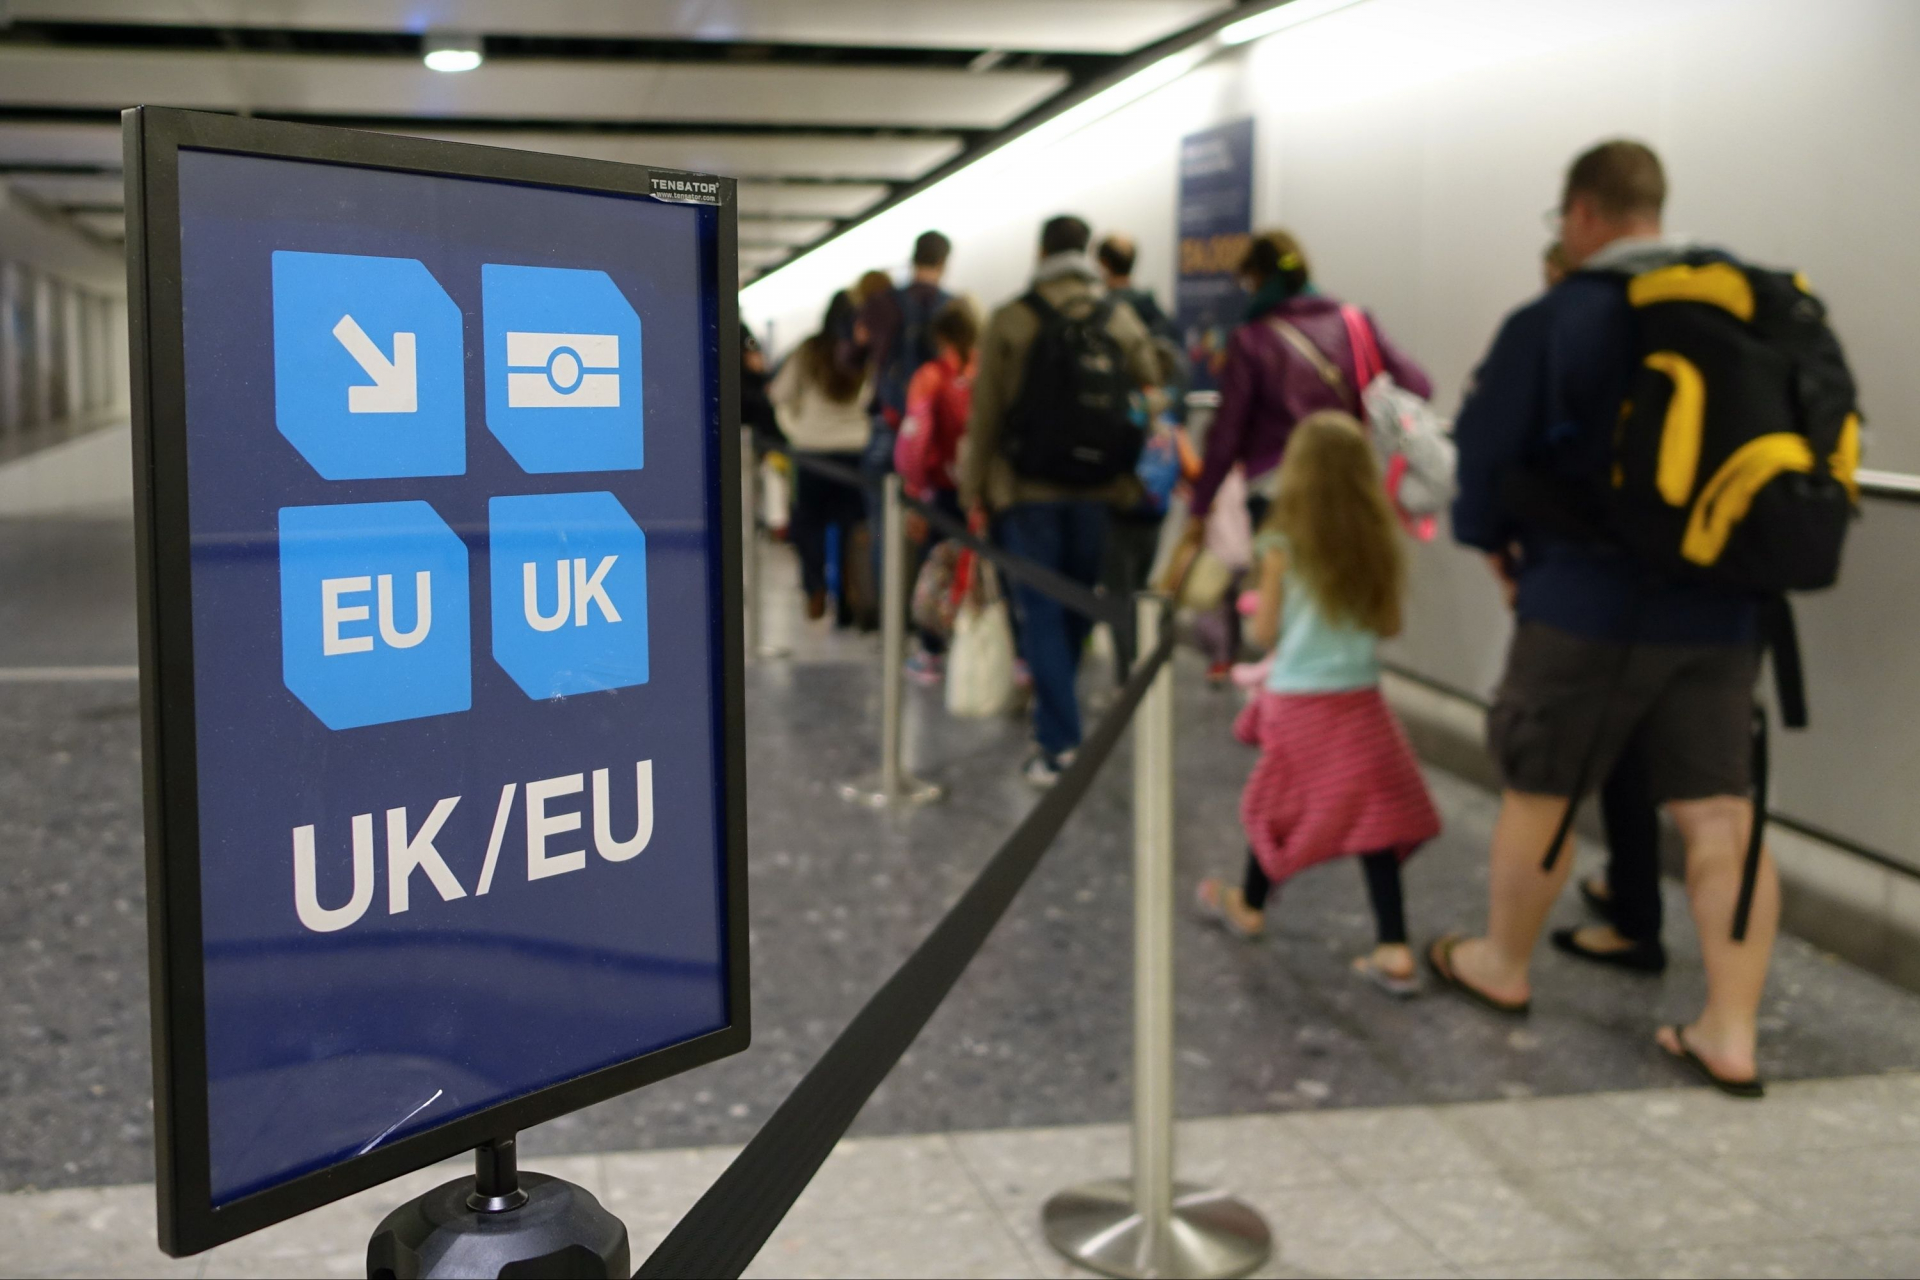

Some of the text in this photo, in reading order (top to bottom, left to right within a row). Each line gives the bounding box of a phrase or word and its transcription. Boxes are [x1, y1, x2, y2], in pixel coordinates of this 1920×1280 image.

[656, 191, 716, 202] www.tensator.com
[321, 571, 432, 656] EU
[523, 555, 622, 632] UK
[293, 759, 654, 933] UK/EU
